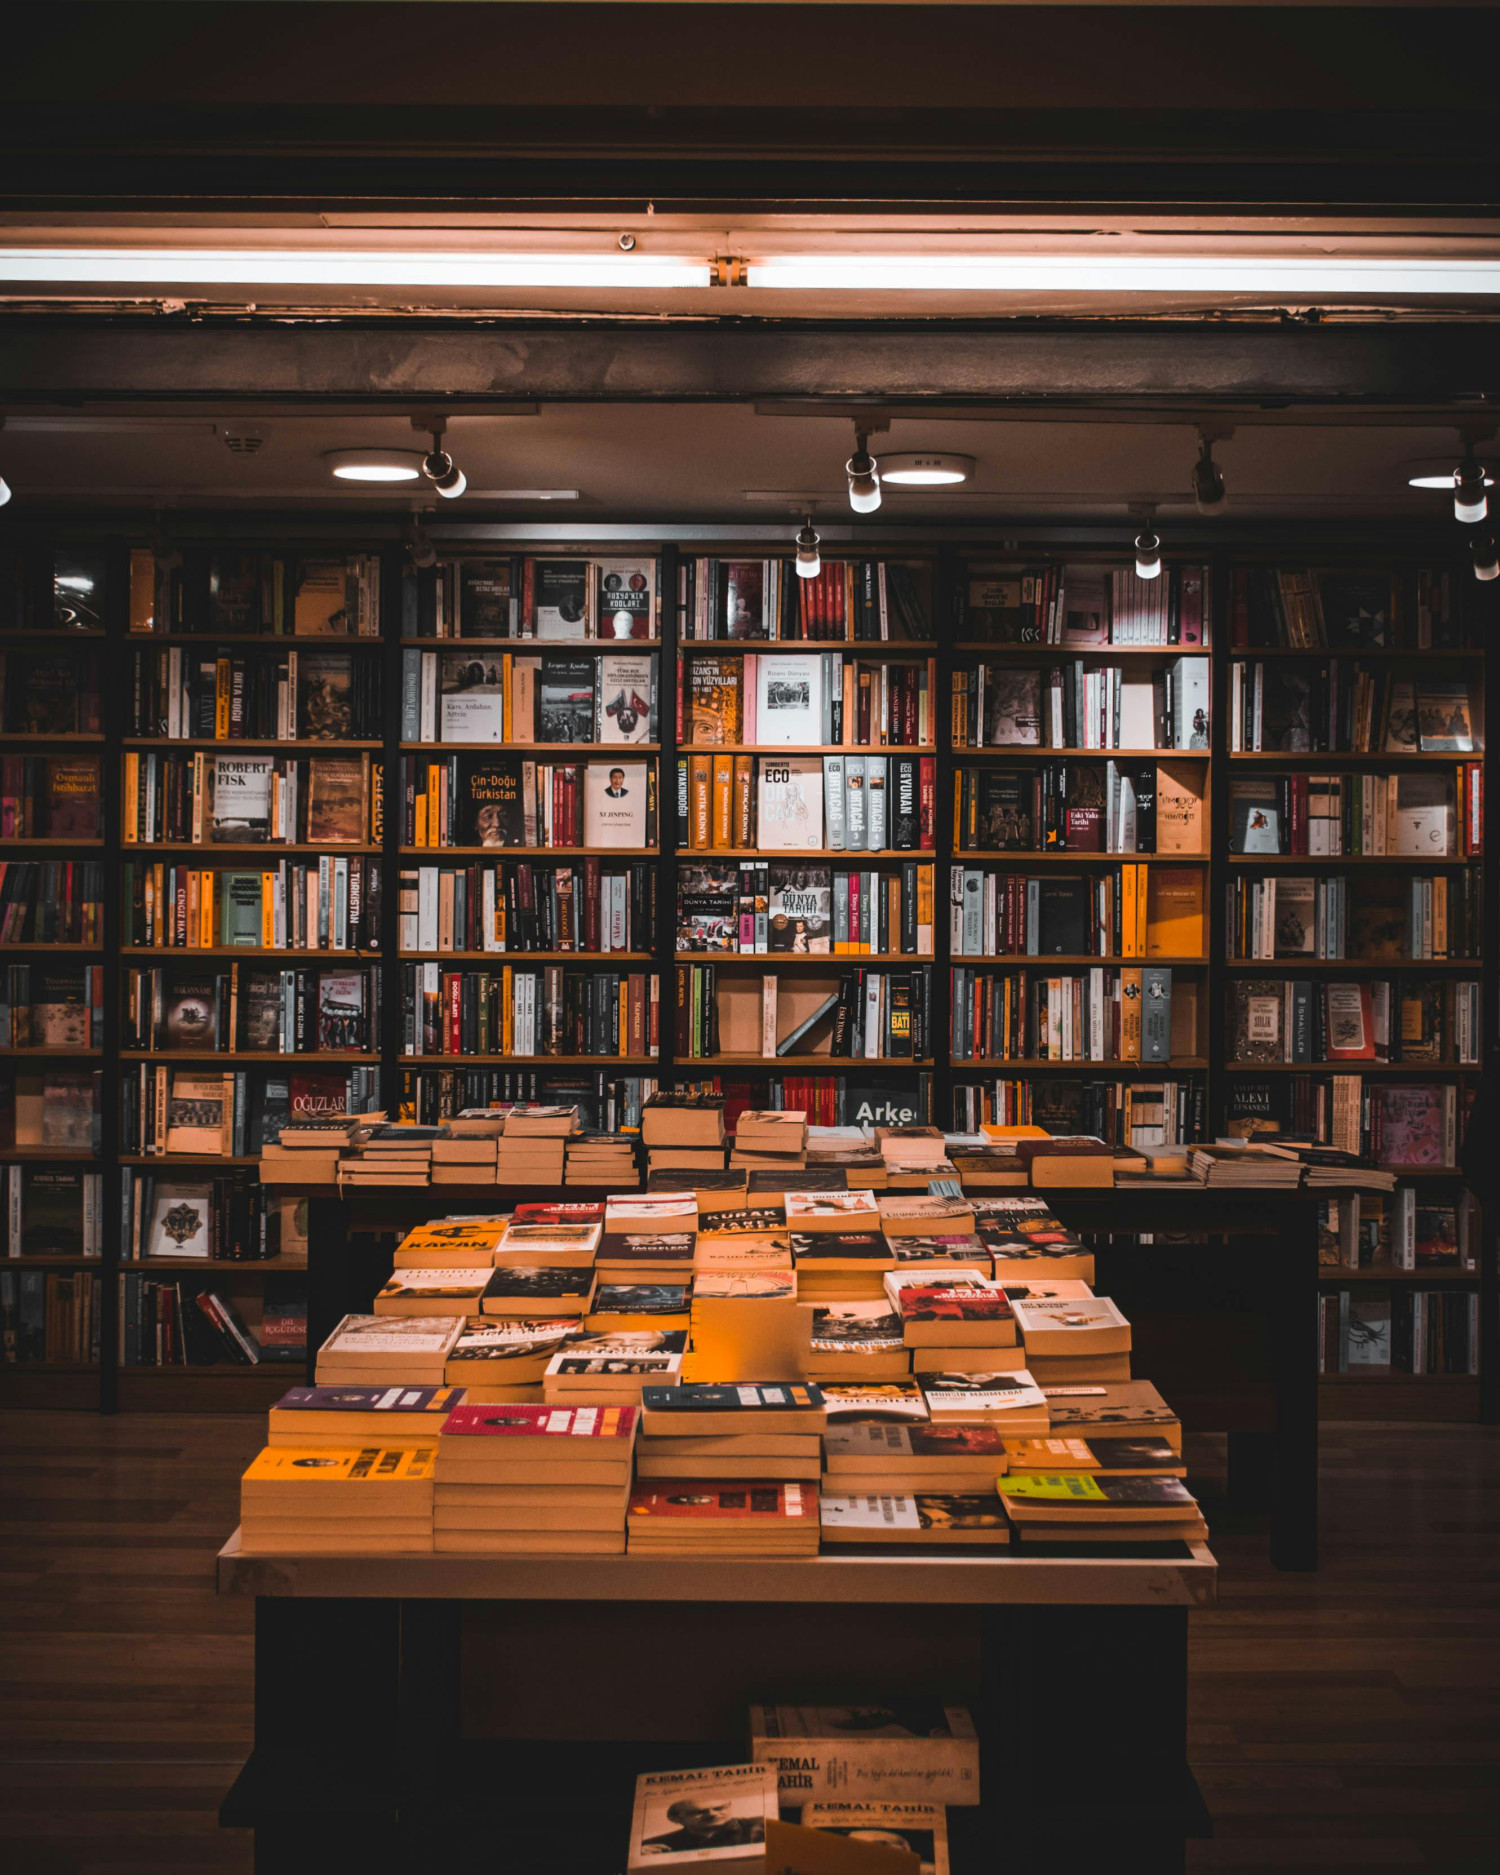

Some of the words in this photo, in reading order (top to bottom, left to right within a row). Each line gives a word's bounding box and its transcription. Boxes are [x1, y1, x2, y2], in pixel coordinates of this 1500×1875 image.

[233, 672, 243, 696] ORTA
[233, 697, 243, 722] DOĞU
[217, 761, 268, 774] ROBERT
[765, 768, 790, 784] ECO
[829, 764, 841, 773] ECO
[217, 774, 247, 787] FISK
[471, 775, 517, 789] Çin-Doğu
[471, 788, 517, 800] Türkistan
[678, 772, 688, 816] YAKINDOĞU
[699, 785, 707, 811] ANTİK
[830, 773, 842, 821] ORTAÇAĞ
[900, 779, 912, 815] YUNAN
[850, 790, 863, 833] ORTAÇAĞ
[870, 791, 882, 833] ORTAÇAĞ
[699, 812, 707, 840] DÜNYA
[1070, 818, 1089, 826] Tarihi
[350, 872, 361, 924] TÜRKİSTAN
[781, 892, 818, 905] DÜNYA
[851, 893, 859, 911] Dünya
[783, 904, 817, 914] TARİHİ
[612, 910, 621, 940] Akdeniz
[851, 911, 859, 928] Tarihi
[177, 920, 186, 940] HAN
[835, 1020, 844, 1043] YUNAN
[891, 1016, 910, 1029] BATI
[1297, 1005, 1305, 1055] İSMAİLİLER
[294, 1094, 346, 1112] OĞUZLAR
[856, 1101, 917, 1121] Arke
[706, 1209, 777, 1220] KURAK
[720, 1218, 766, 1227] JANE
[408, 1240, 488, 1250] KAPAN
[645, 1771, 709, 1786] KEMAL
[712, 1764, 767, 1779] TAHİR
[777, 1771, 814, 1789] AHİR
[813, 1801, 875, 1812] KEMAL
[880, 1802, 937, 1814] TAHİR
